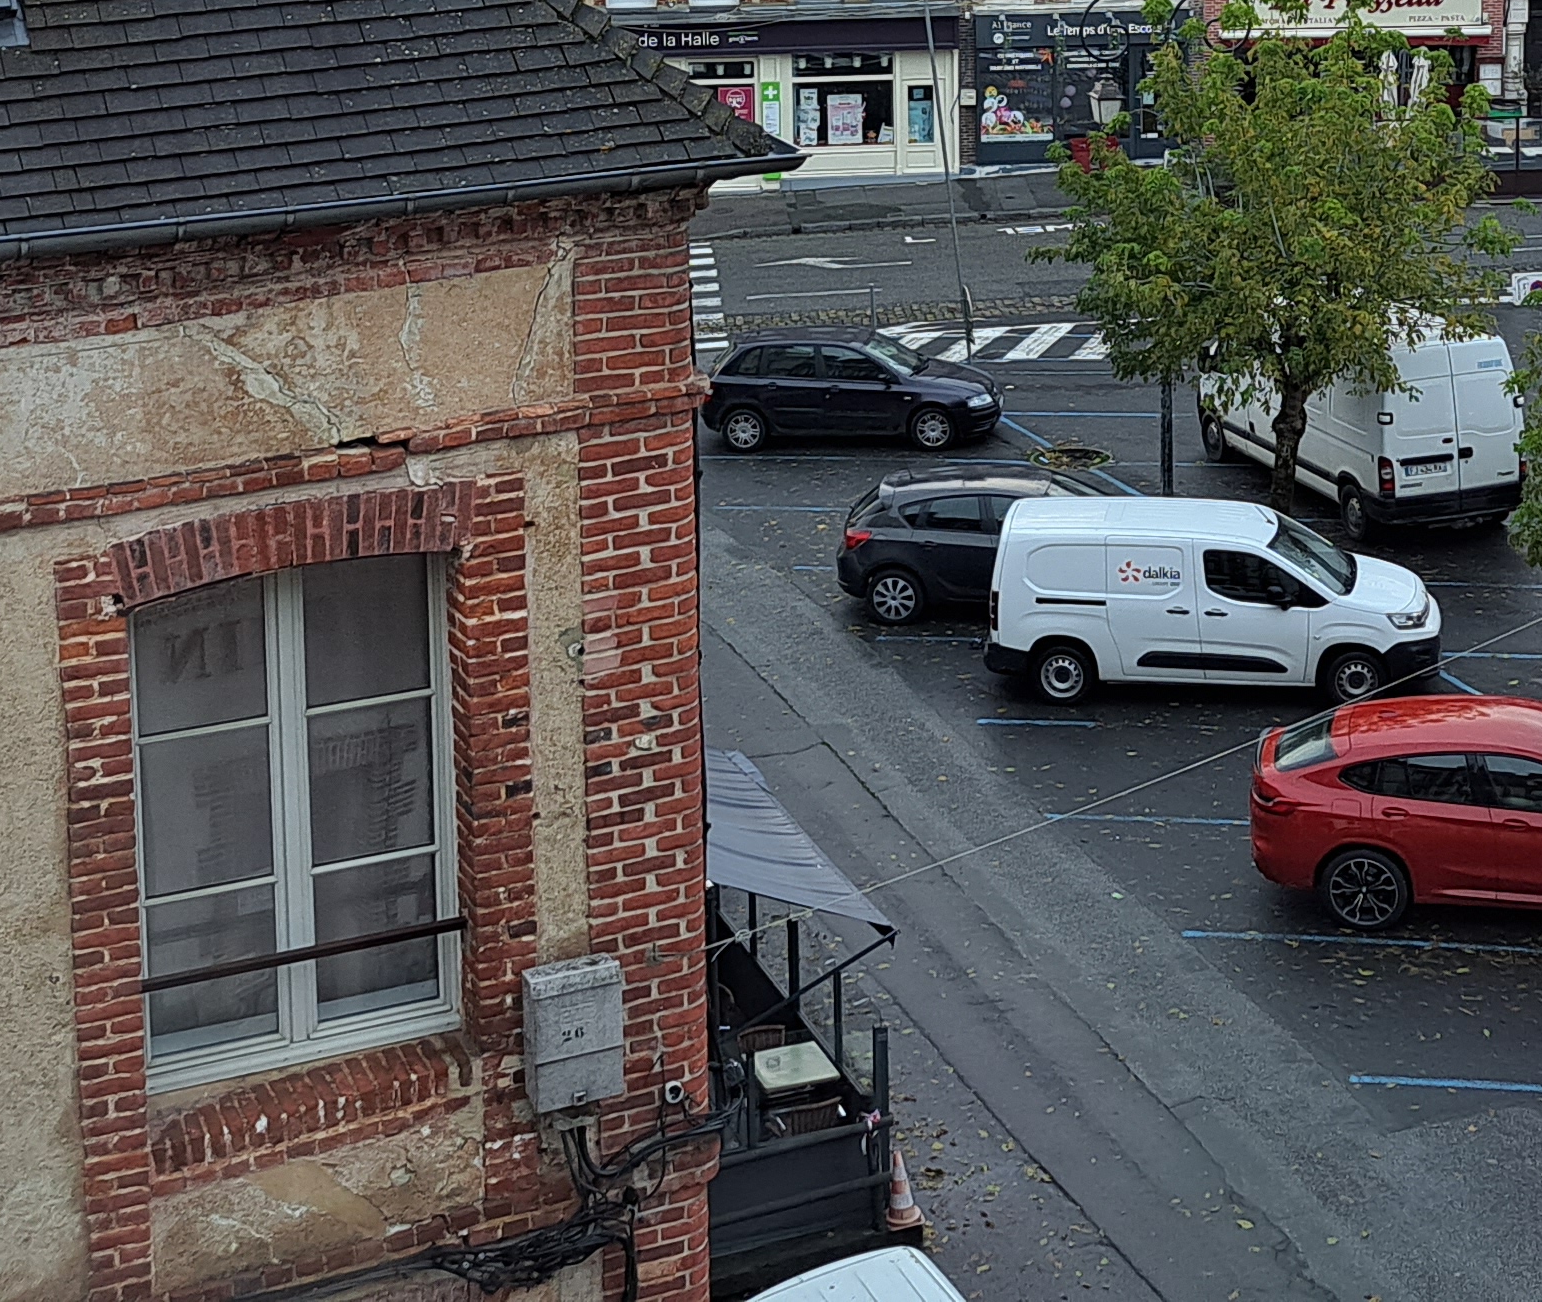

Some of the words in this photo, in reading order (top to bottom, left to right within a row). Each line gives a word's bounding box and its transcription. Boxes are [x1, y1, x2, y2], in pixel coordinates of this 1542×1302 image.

[638, 33, 659, 47] de
[663, 32, 676, 47] la
[681, 31, 721, 47] Halle
[1142, 565, 1181, 580] dalkia
